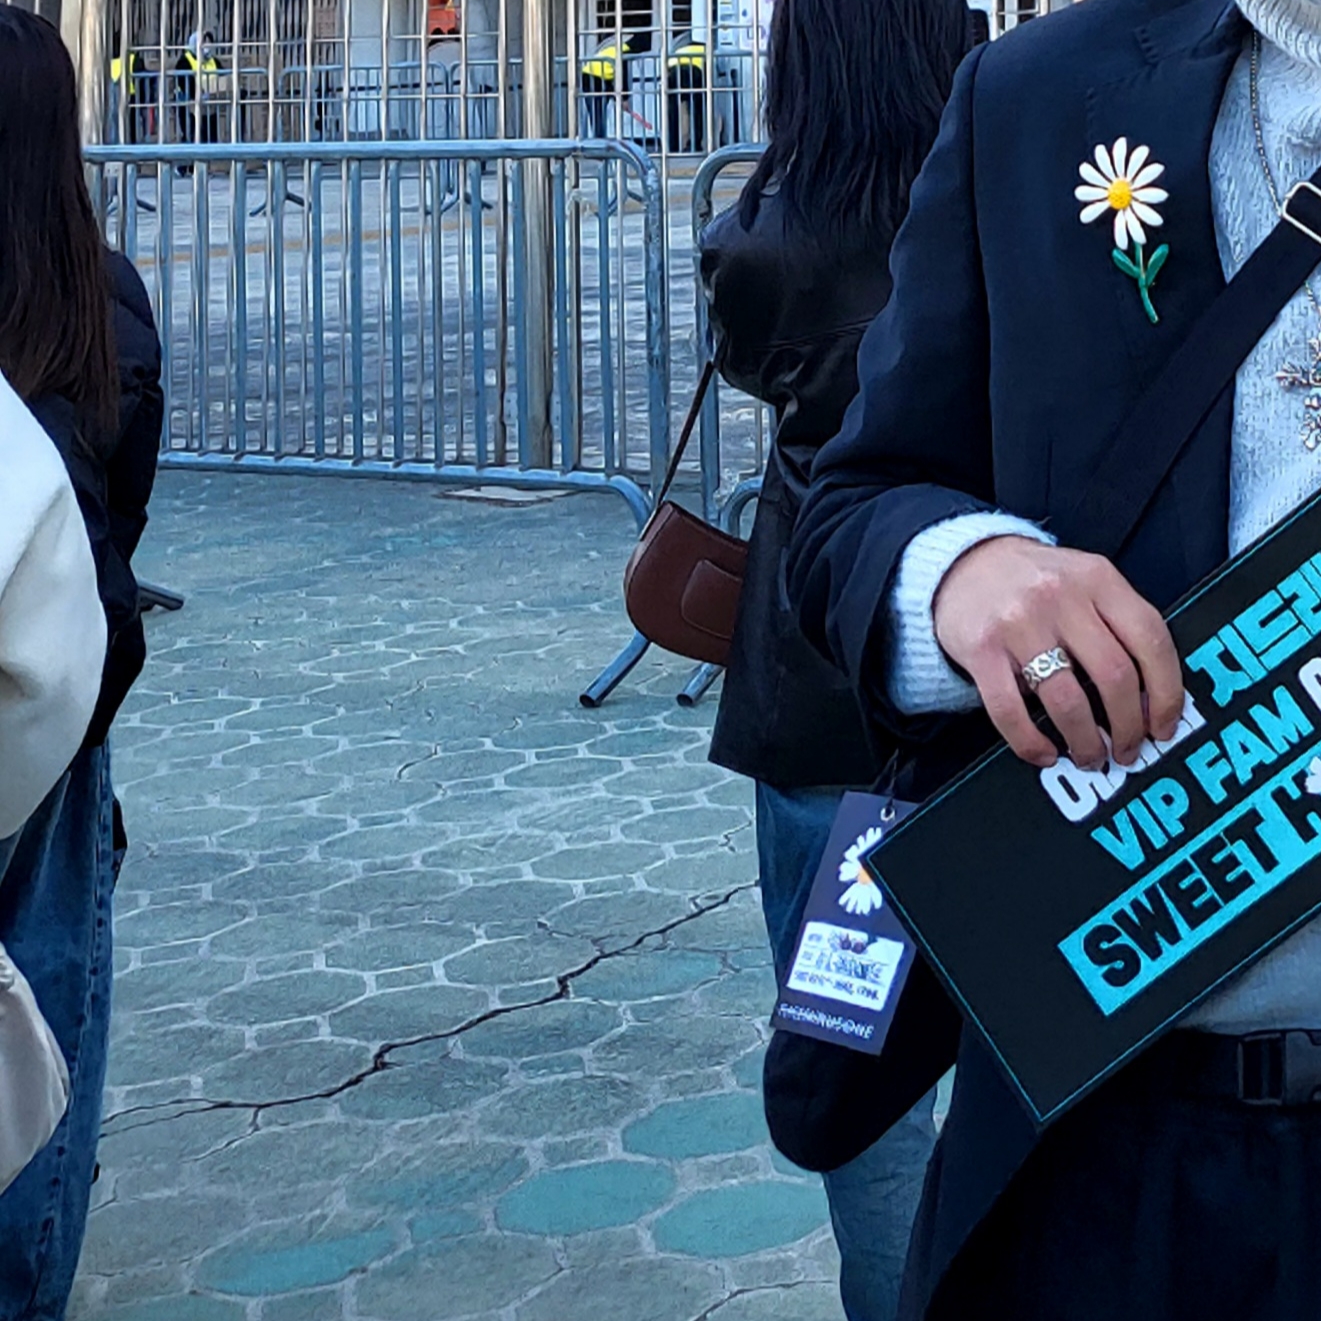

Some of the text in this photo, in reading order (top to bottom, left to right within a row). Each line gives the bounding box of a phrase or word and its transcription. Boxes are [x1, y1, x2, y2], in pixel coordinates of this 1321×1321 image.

[1090, 777, 1190, 871] VIP
[1184, 685, 1315, 805] FAM
[1082, 802, 1281, 988] SWEET
